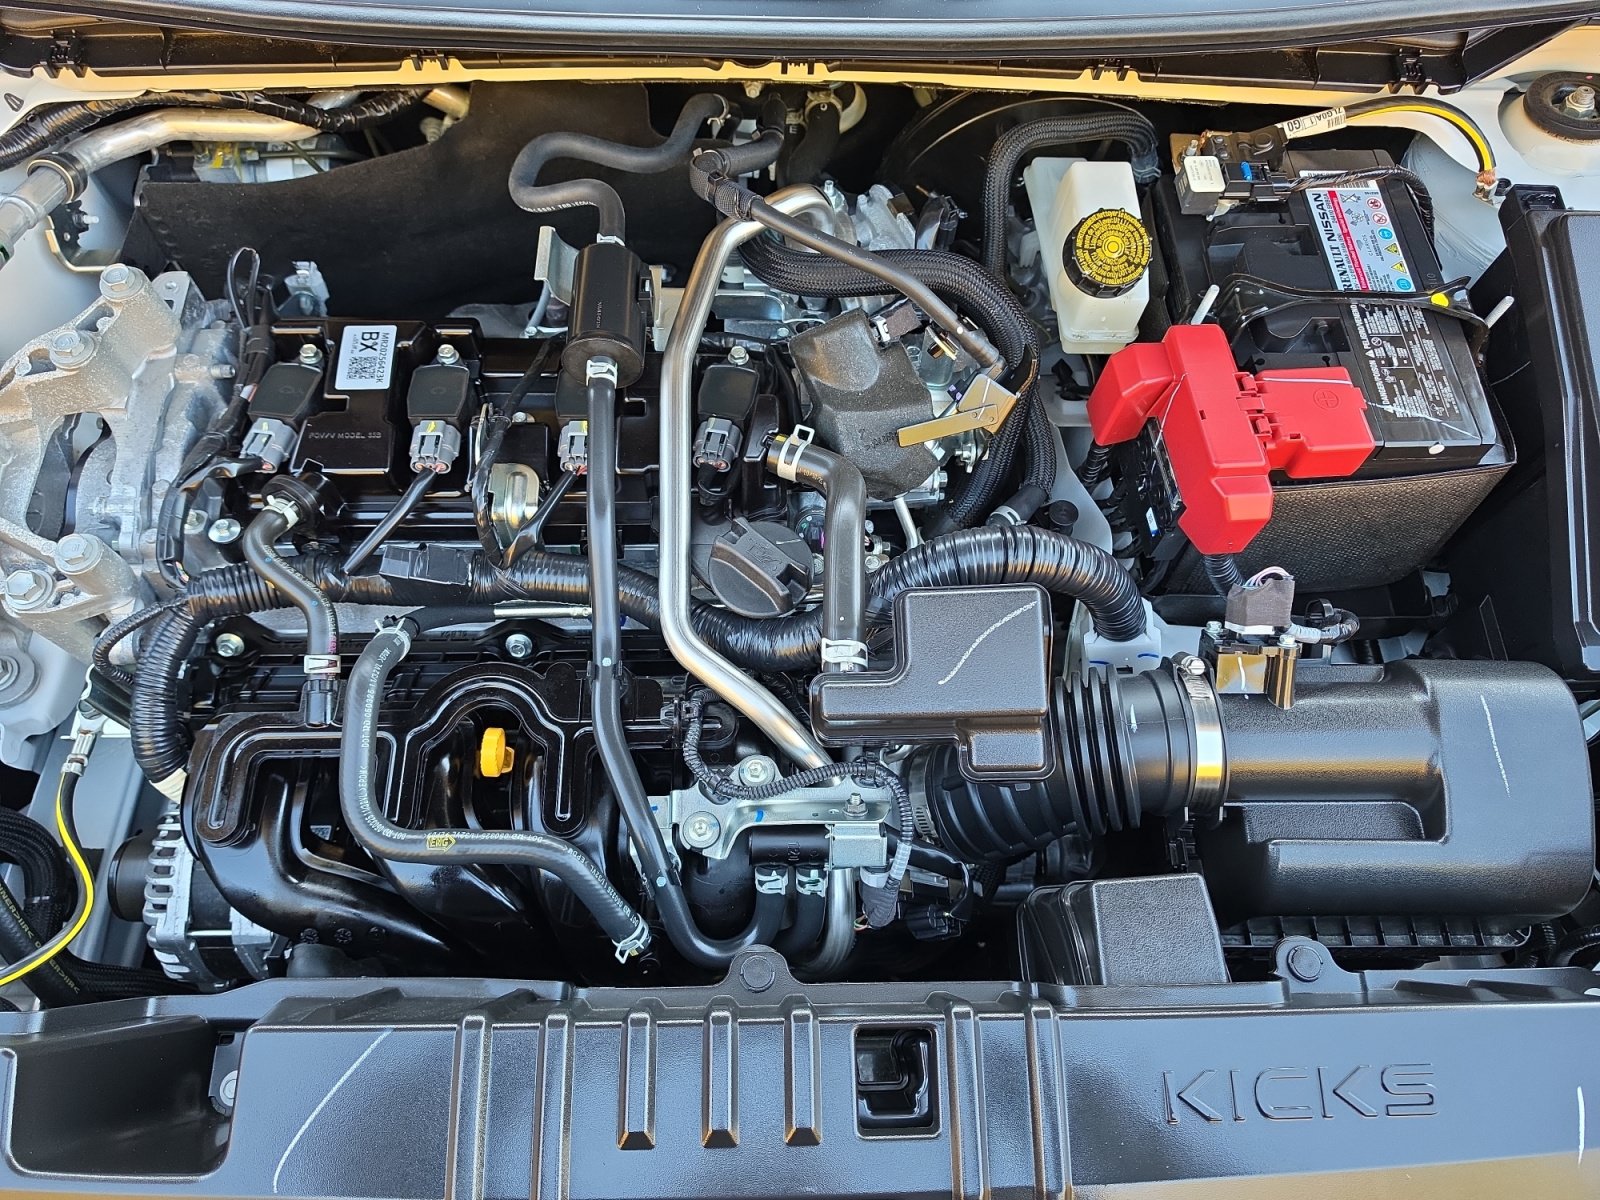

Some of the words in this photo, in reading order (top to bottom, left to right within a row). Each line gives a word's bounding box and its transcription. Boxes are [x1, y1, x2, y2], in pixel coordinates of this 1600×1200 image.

[1312, 193, 1336, 242] NISSAN
[1330, 243, 1354, 290] RENAULT
[358, 332, 380, 352] BX
[1370, 360, 1390, 404] DANGER/POISON
[429, 838, 448, 848] ENG
[1162, 1064, 1438, 1125] KICKS
